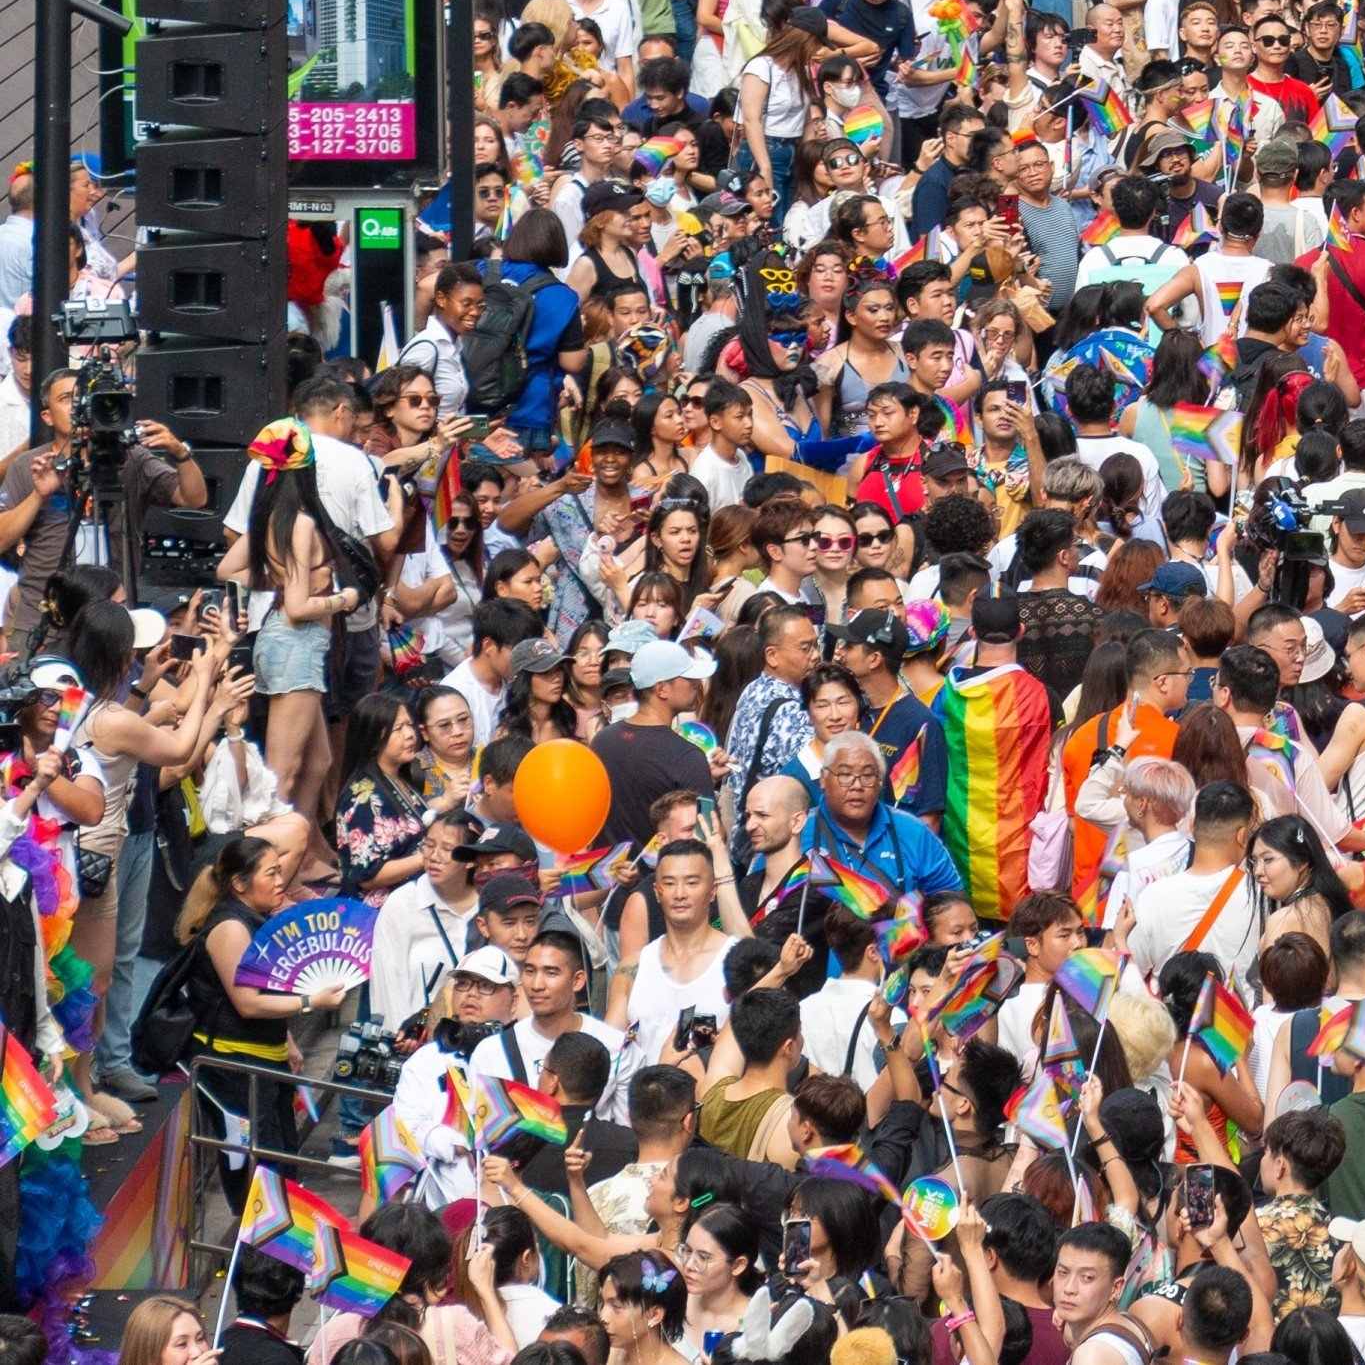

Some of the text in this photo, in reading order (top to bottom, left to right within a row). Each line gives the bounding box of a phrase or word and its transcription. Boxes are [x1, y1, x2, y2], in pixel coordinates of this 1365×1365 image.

[91, 298, 100, 308] 3
[271, 911, 341, 951] I'M TOO
[267, 931, 373, 991] FIERCEBULOUS
[917, 1187, 938, 1227] MBK
[929, 1191, 946, 1230] CENTER
